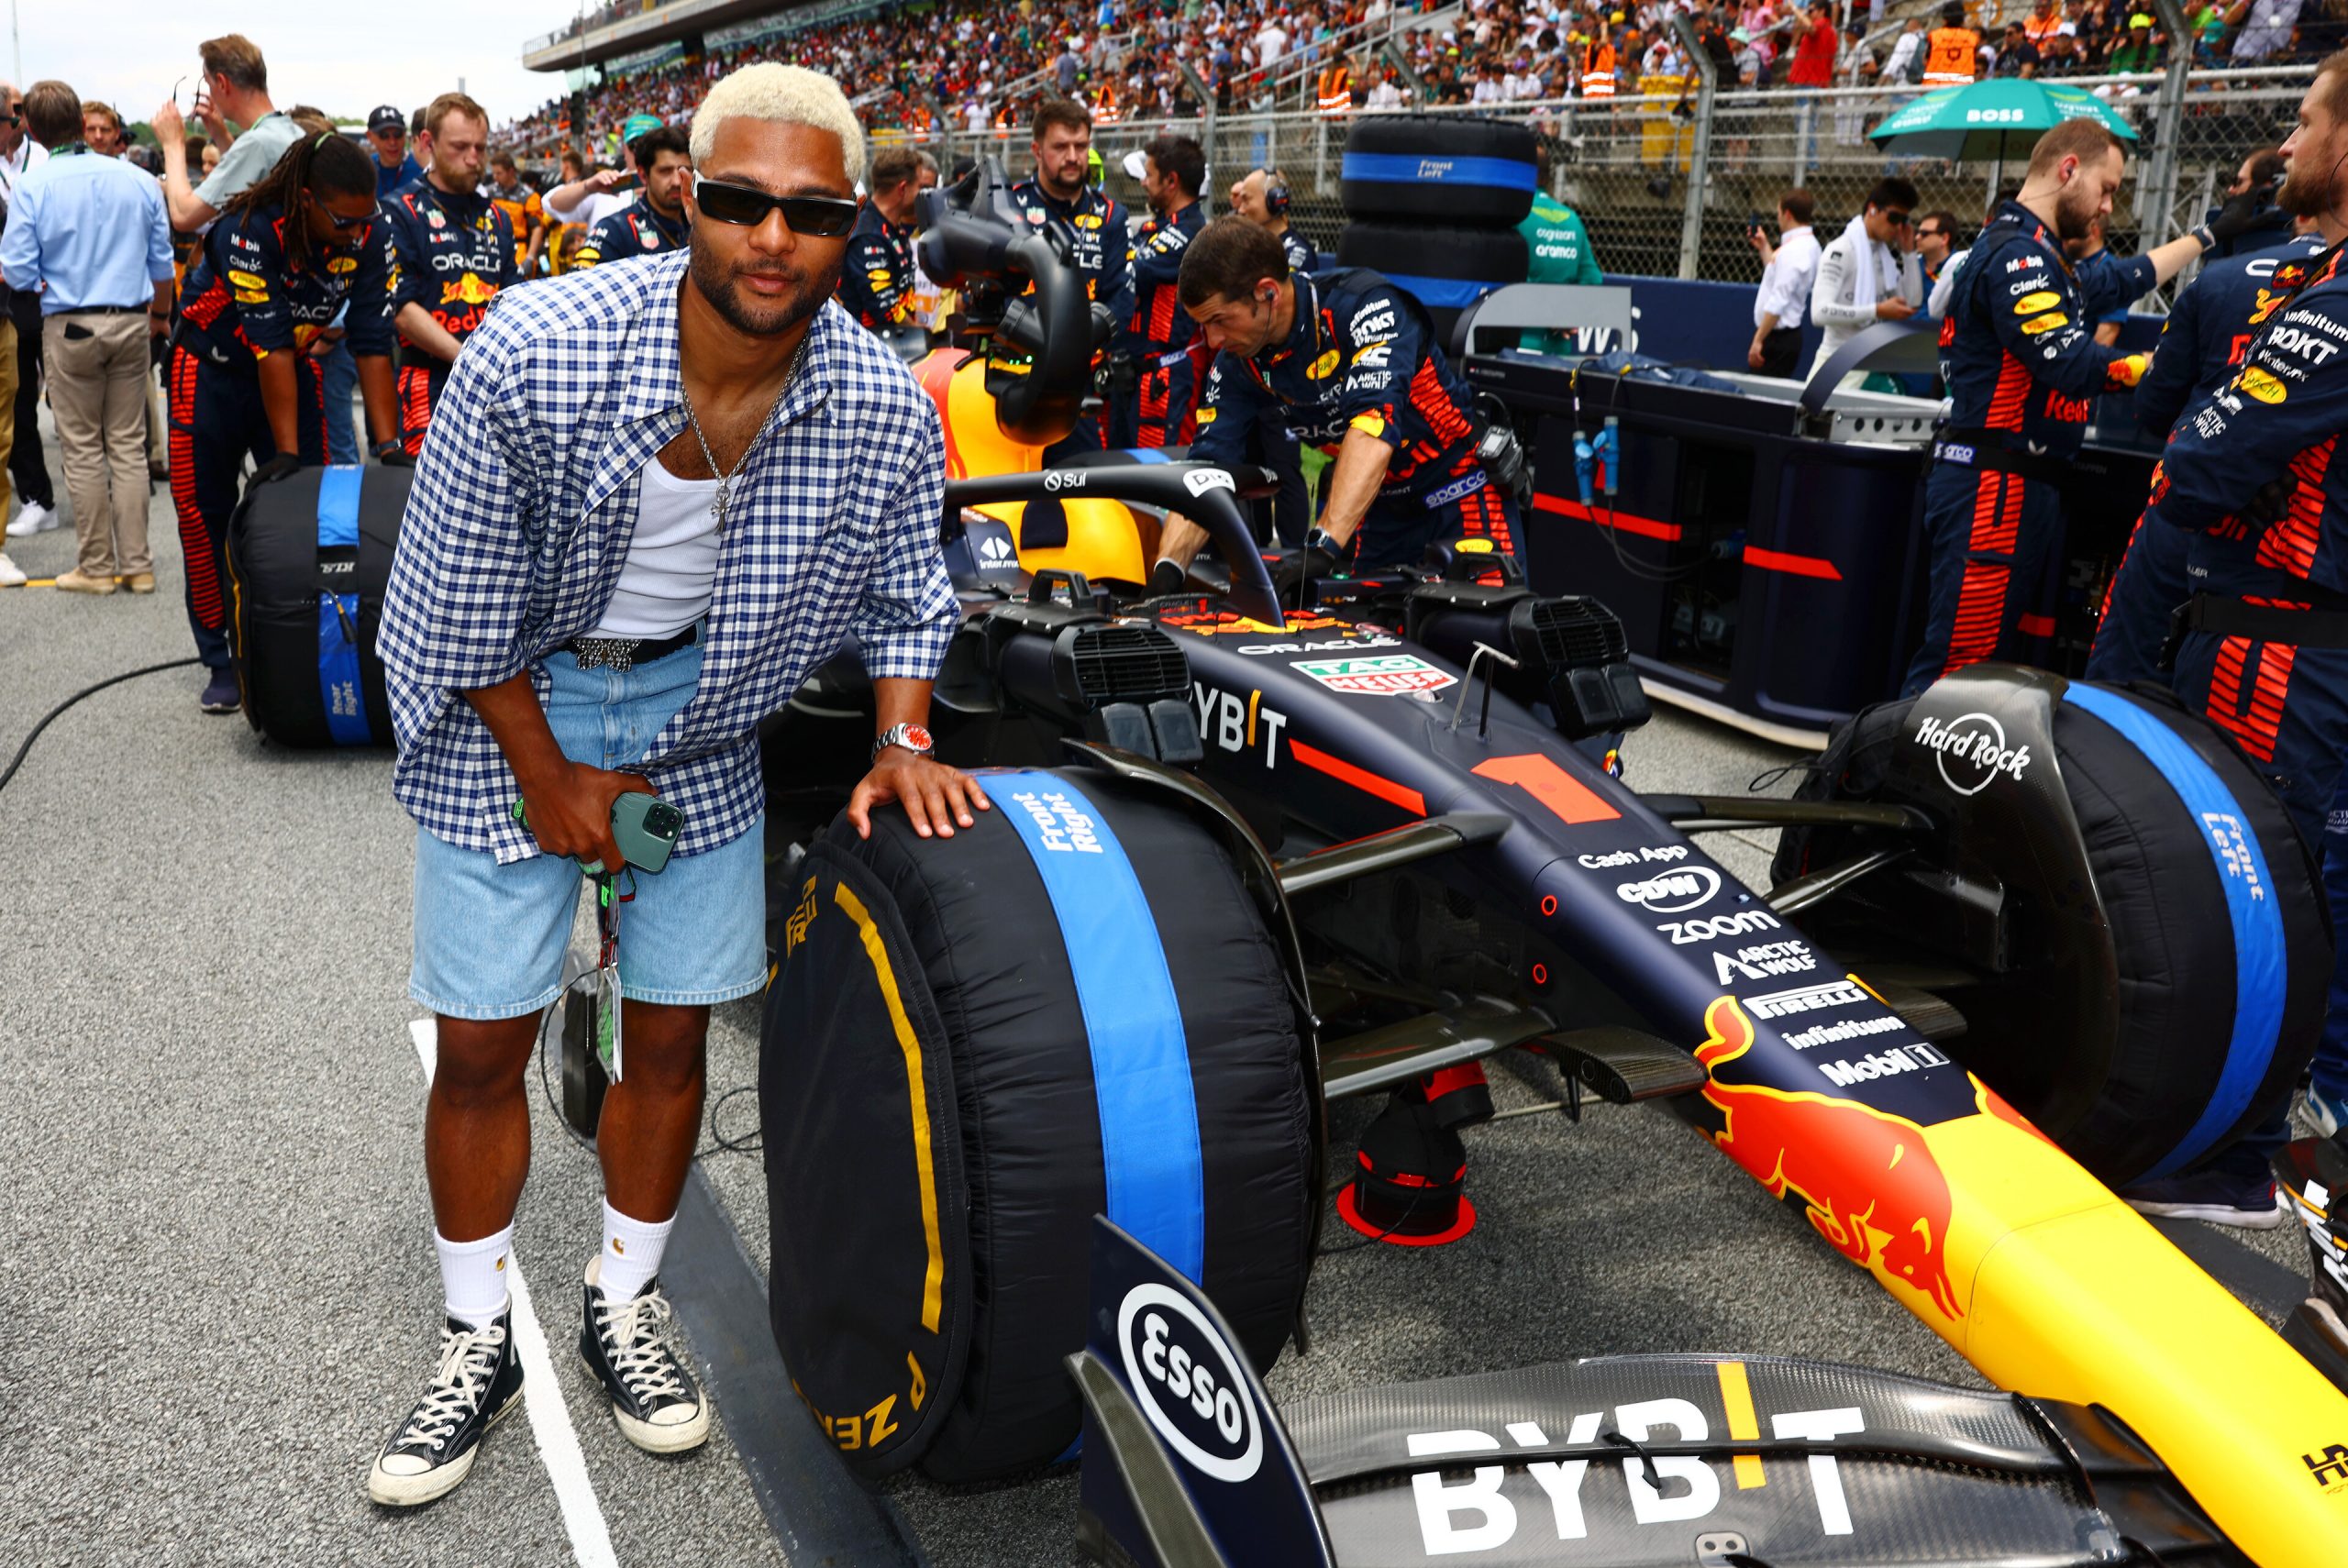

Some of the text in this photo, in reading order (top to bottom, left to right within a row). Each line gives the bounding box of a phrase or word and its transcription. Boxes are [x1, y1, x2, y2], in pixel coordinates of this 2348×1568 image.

[1966, 108, 2024, 123] BOSS
[1417, 169, 1443, 178] Left
[1420, 160, 1453, 171] Front
[230, 233, 260, 252] Mobil
[1535, 244, 1578, 259] aramco
[2006, 255, 2044, 273] Mobil
[2266, 325, 2340, 366] ROKT
[1357, 370, 1392, 383] ARCTIC
[1360, 380, 1390, 390] WOLF
[1933, 444, 1973, 460] sarco
[1064, 472, 1087, 488] Sui
[1425, 469, 1488, 505] sparco
[1237, 636, 1402, 655] ORACLE
[1307, 657, 1420, 675] TAG
[1330, 670, 1443, 693] HEUER
[331, 683, 344, 715] Rear
[343, 680, 357, 717] Right
[1194, 681, 1287, 769] YBIT
[1914, 717, 2031, 781] Hard Rock
[1470, 752, 1623, 825] 1
[1011, 791, 1074, 853] Front
[1039, 791, 1104, 855] Right
[1578, 844, 1689, 870] Cash App
[2200, 811, 2242, 879] Left
[2216, 812, 2265, 902] Front
[1616, 871, 1700, 904] CDW
[1656, 910, 1782, 945] zoom
[1738, 940, 1811, 965] ARCTIC
[1758, 956, 1817, 979] WOLF
[1743, 980, 1869, 1021] PIRELLI
[1781, 1014, 1906, 1052] infinitum
[1819, 1047, 1919, 1088] Mobil
[906, 1351, 927, 1412] P
[1140, 1312, 1243, 1445] ESSO
[1406, 1361, 1866, 1556] BYBIT
